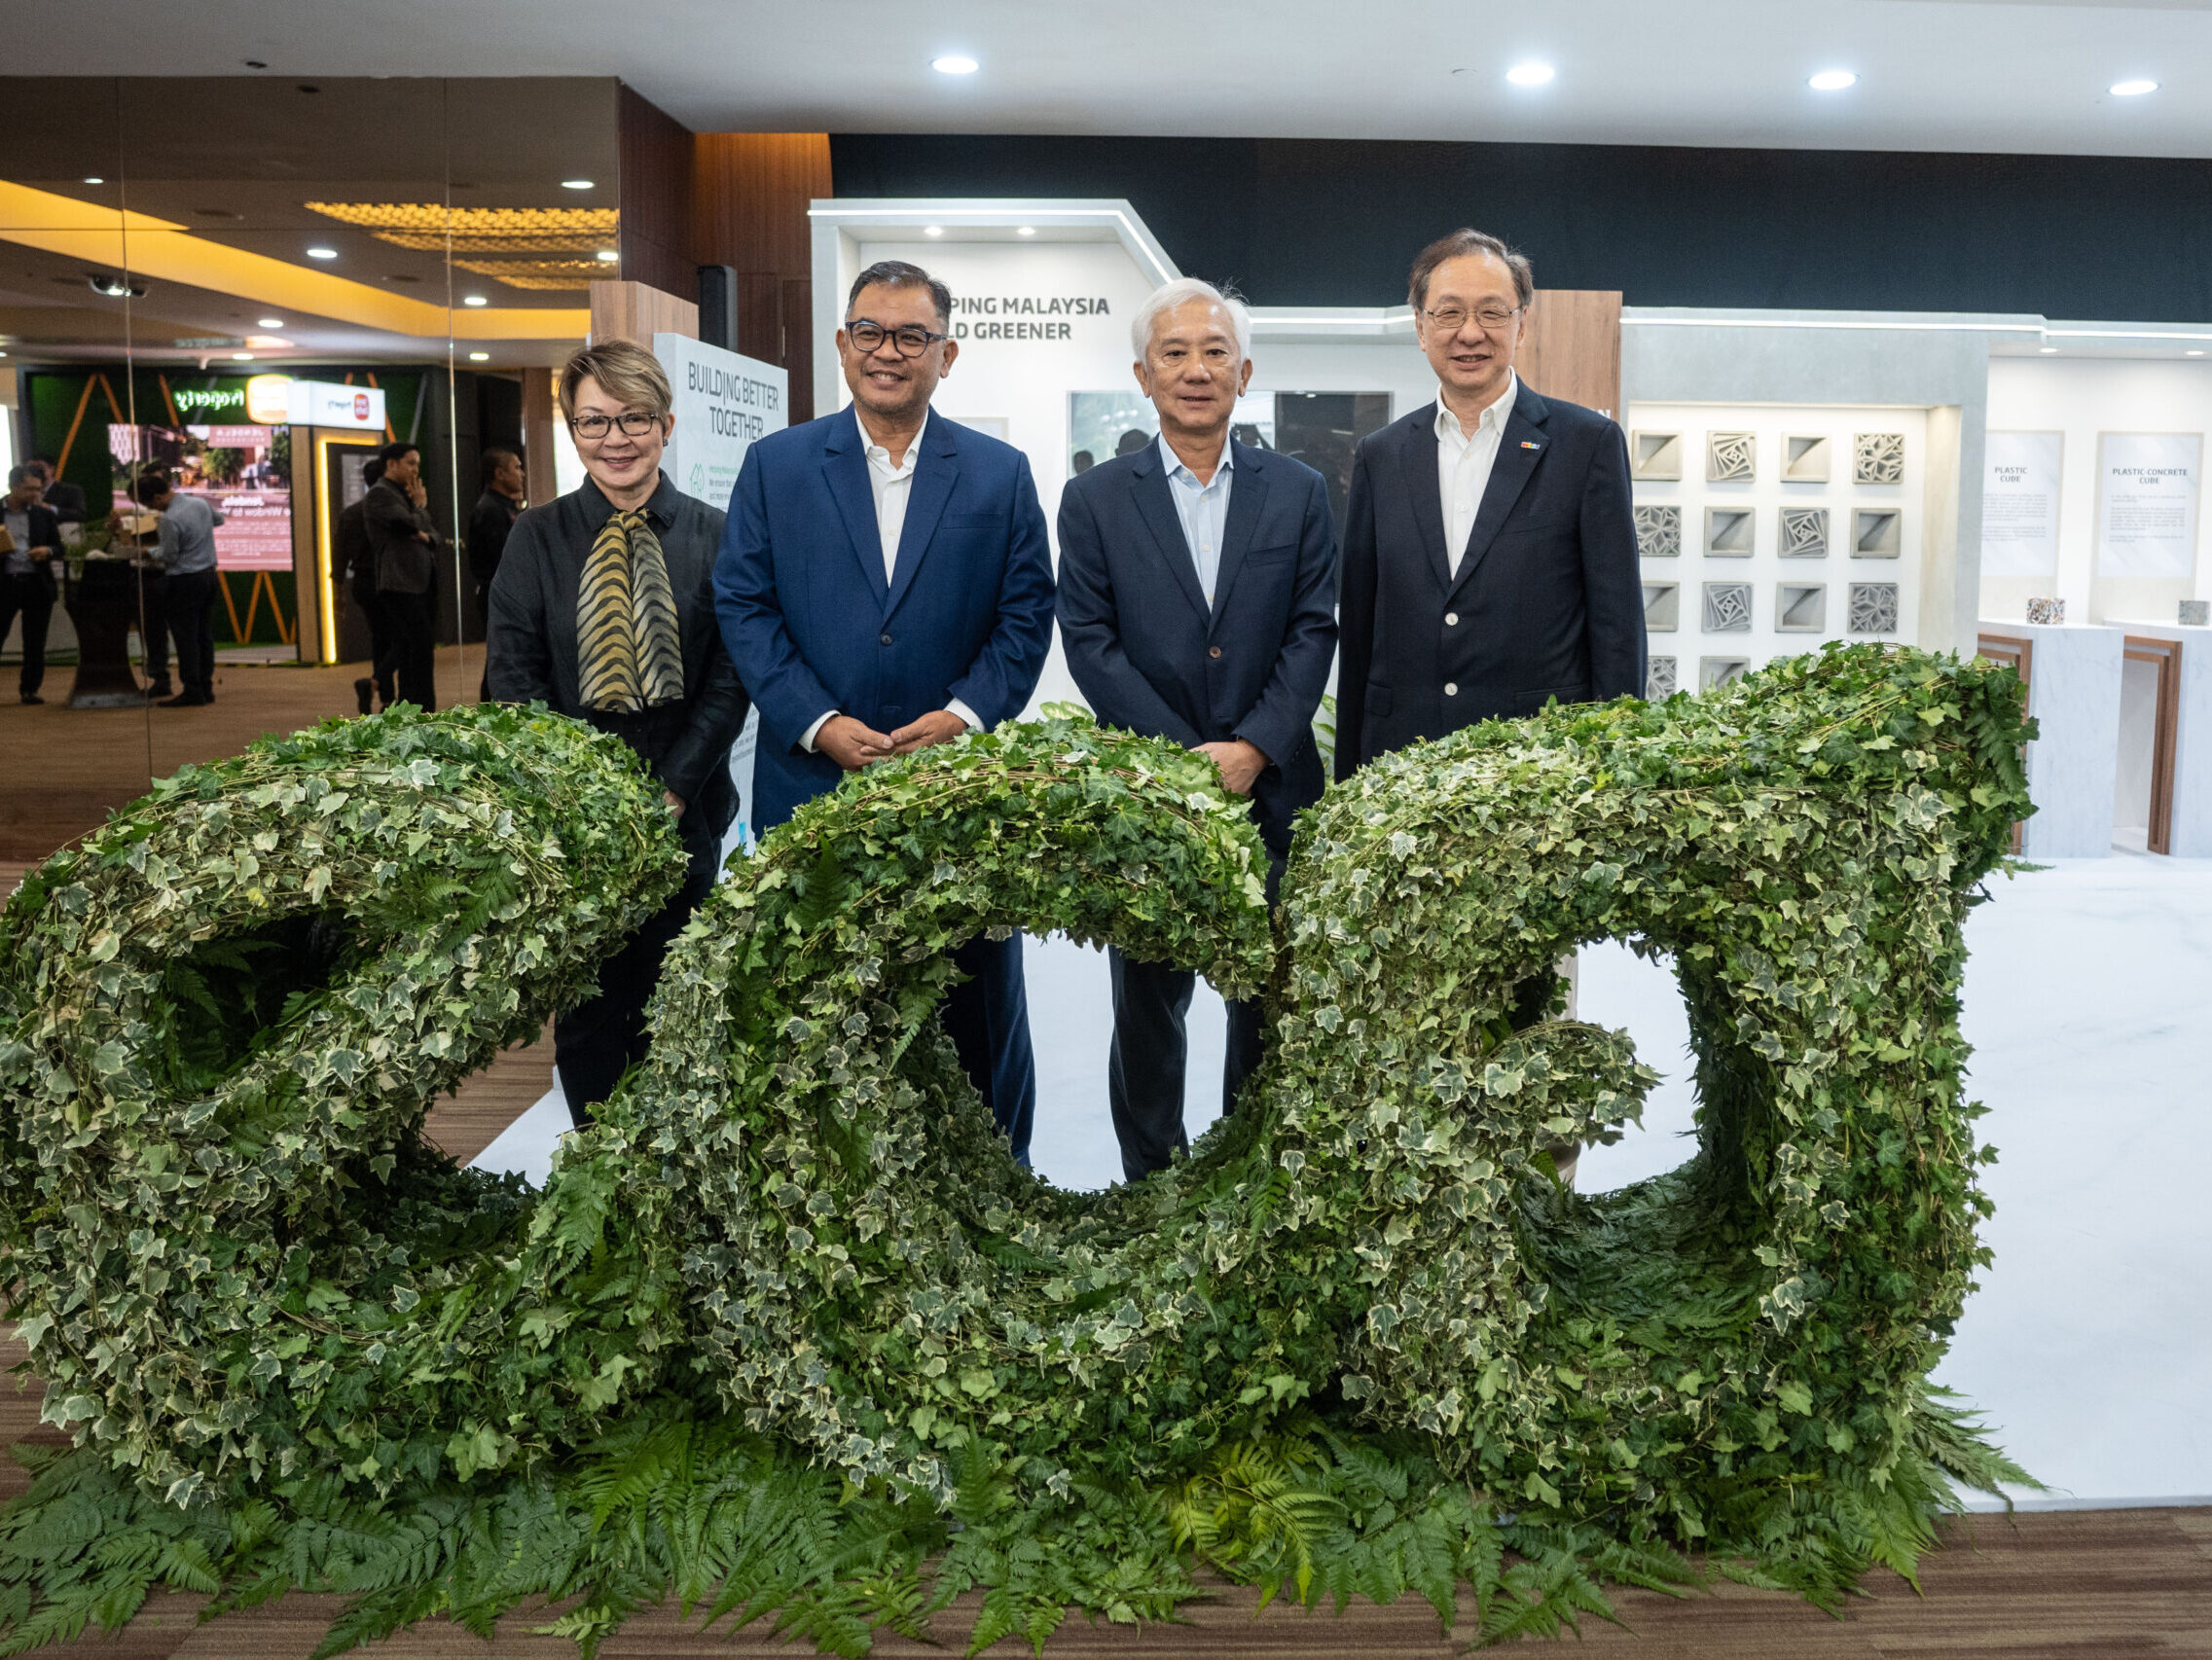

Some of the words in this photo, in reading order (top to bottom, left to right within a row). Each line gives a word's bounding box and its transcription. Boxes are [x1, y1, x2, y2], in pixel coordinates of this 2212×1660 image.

[1002, 298, 1111, 315] MALAYSIA
[974, 322, 1072, 341] GREENER
[688, 361, 741, 405] BUILDING
[743, 376, 780, 412] BETTER
[709, 406, 765, 440] TOGETHER
[1994, 466, 2029, 475] PLASTIC
[2112, 468, 2146, 477] PLASTIC
[2146, 468, 2189, 477] CONCRETE
[2000, 475, 2022, 484] CUBE
[2138, 476, 2160, 485] CUBE
